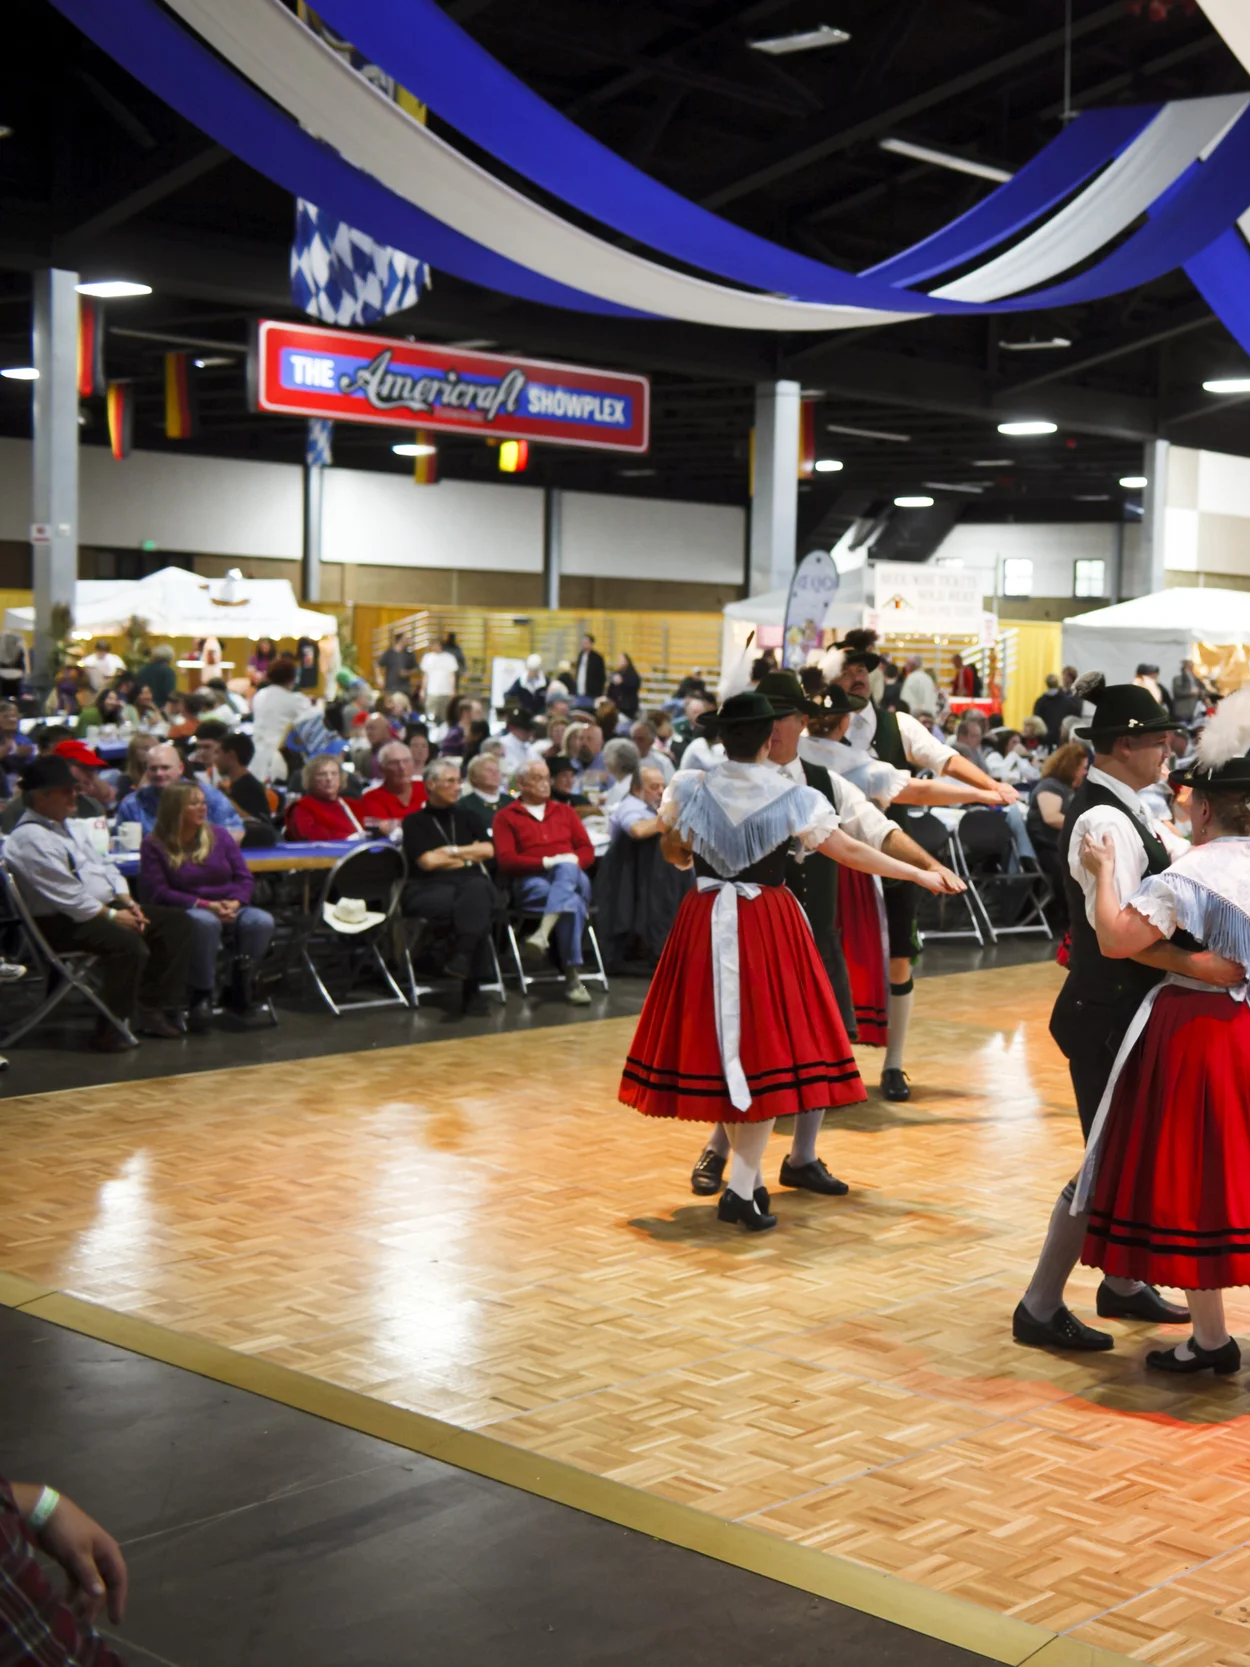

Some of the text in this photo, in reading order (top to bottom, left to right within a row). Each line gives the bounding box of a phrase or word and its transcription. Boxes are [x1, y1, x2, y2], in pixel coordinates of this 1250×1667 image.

[290, 354, 335, 388] THE
[339, 348, 526, 421] Americraft
[527, 386, 626, 424] SHOWPLEX
